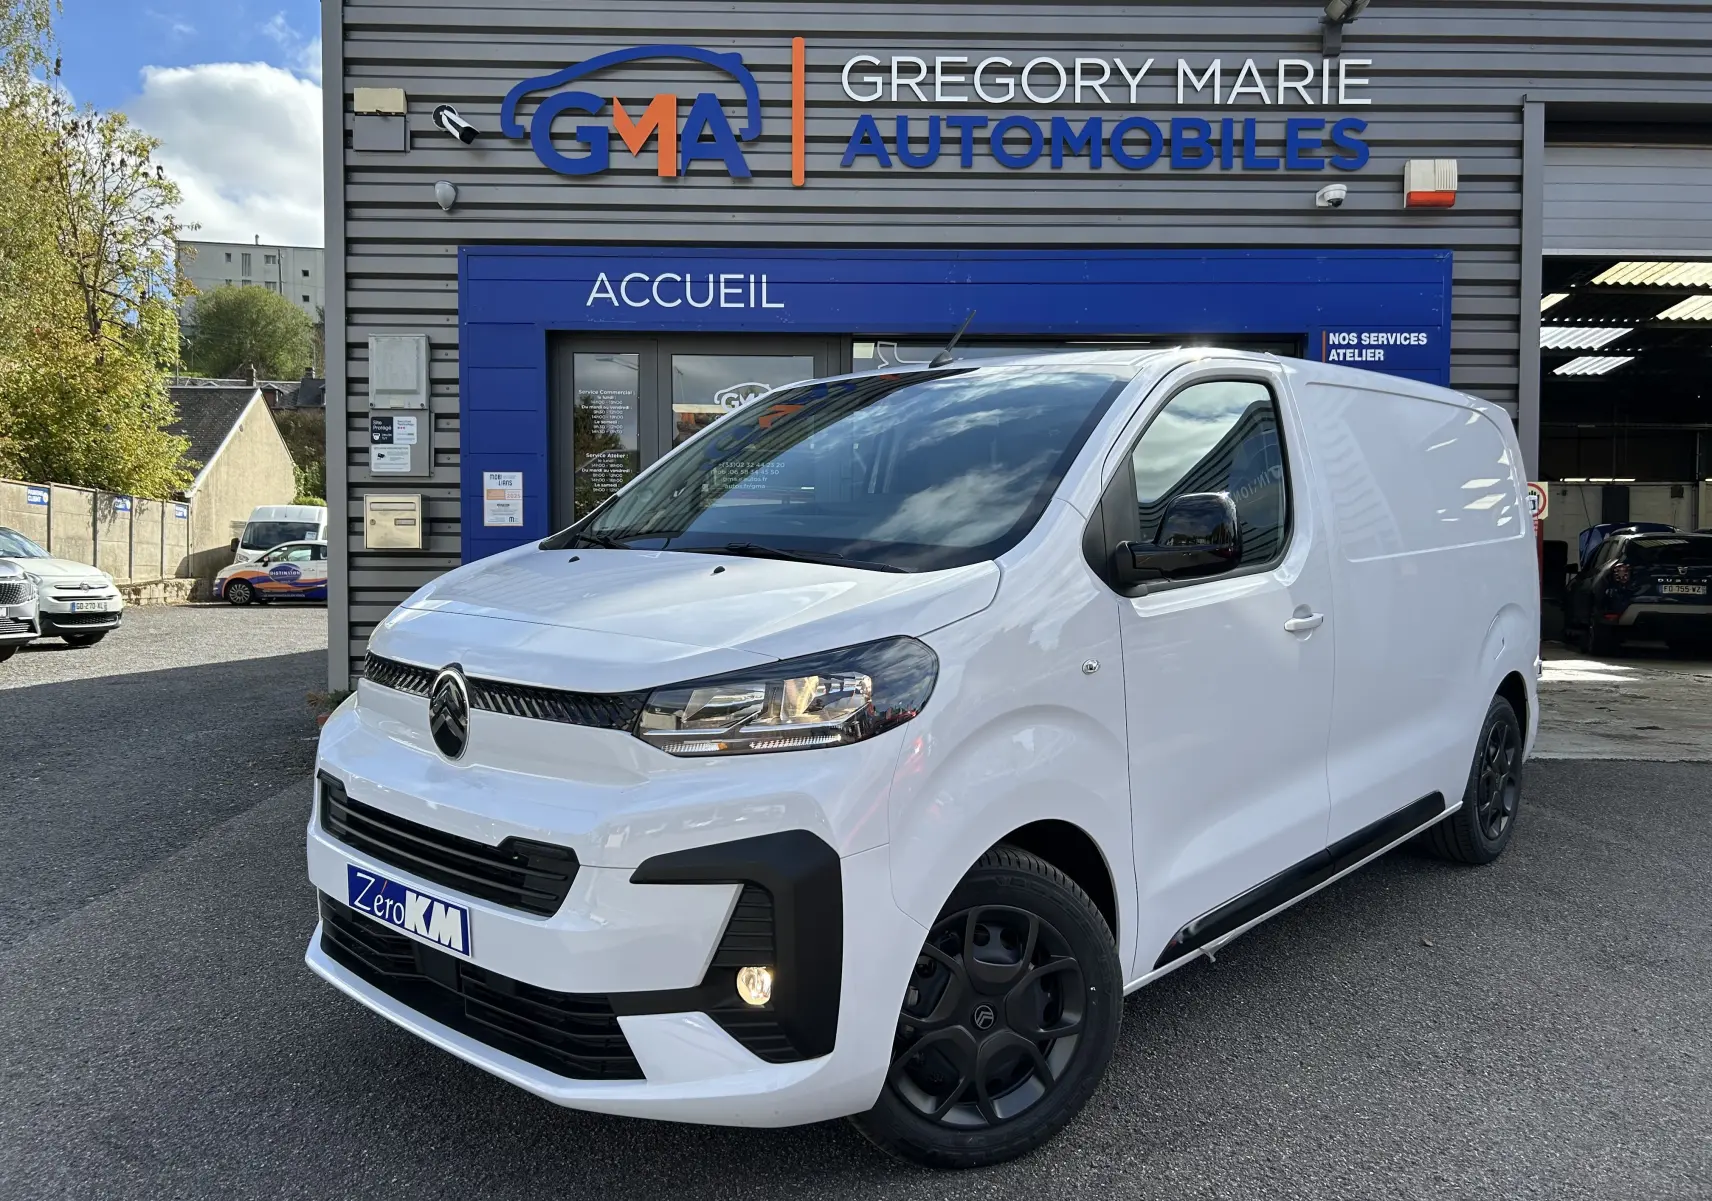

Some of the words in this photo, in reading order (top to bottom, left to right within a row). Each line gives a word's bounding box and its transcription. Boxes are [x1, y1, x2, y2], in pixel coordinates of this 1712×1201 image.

[841, 55, 1153, 105] GREGORY
[1177, 57, 1373, 106] MARIE
[530, 90, 752, 178] GMA
[840, 114, 1370, 171] AUTOMOBILES
[586, 272, 785, 309] ACCUEIL
[1328, 349, 1384, 361] ATELIER
[1329, 332, 1358, 345] NOS
[1361, 332, 1427, 345] SERVICES
